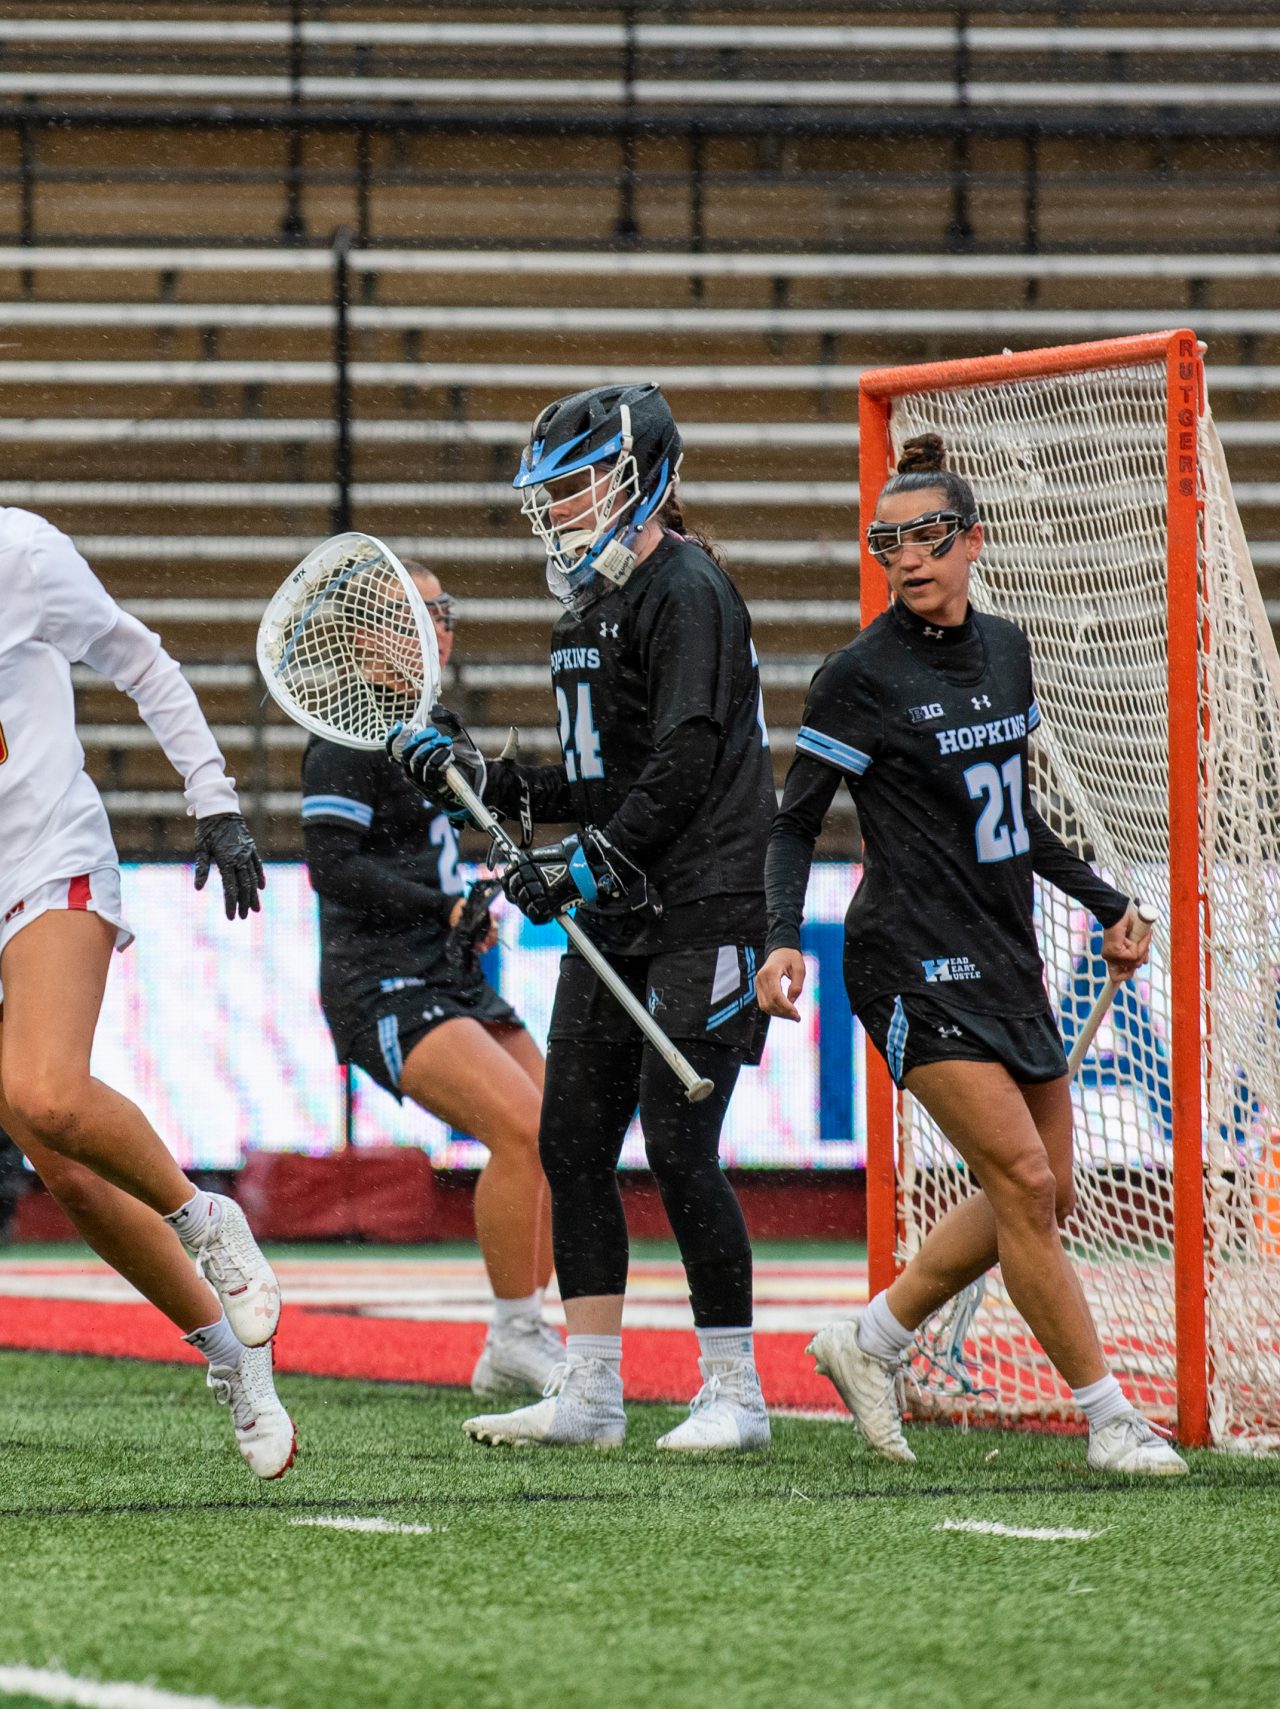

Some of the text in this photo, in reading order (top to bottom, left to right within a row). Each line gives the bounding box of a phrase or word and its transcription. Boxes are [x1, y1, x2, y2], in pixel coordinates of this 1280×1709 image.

[1178, 339, 1194, 497] RUTGERS
[292, 567, 307, 585] STX
[551, 647, 601, 676] OPKINS
[935, 713, 1026, 756] HOPKINS
[963, 753, 1030, 863] 21
